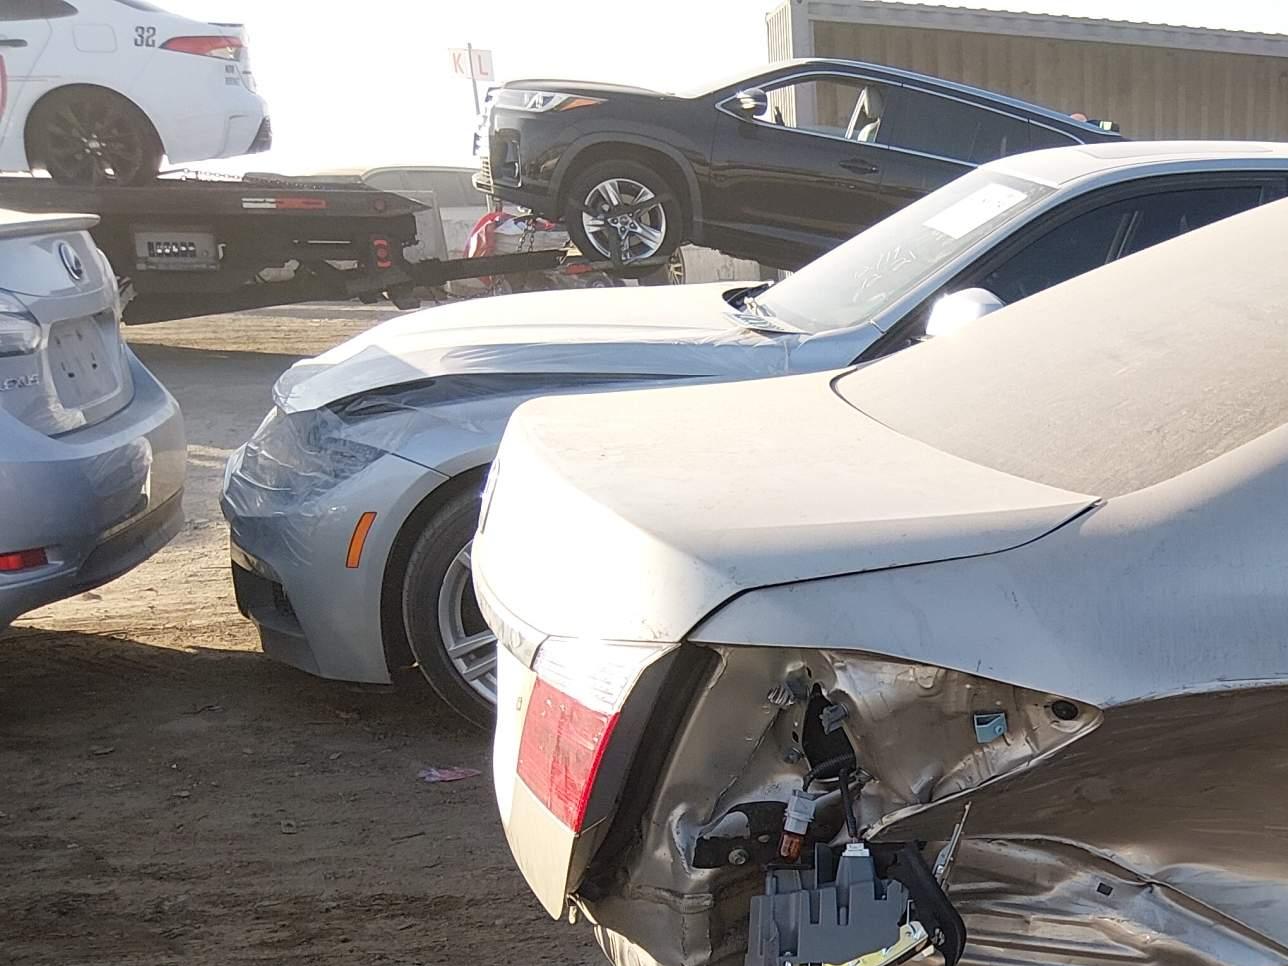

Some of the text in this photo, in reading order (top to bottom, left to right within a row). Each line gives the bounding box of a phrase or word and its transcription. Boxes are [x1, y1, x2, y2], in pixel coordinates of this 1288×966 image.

[133, 25, 157, 48] 32
[452, 52, 489, 76] K L
